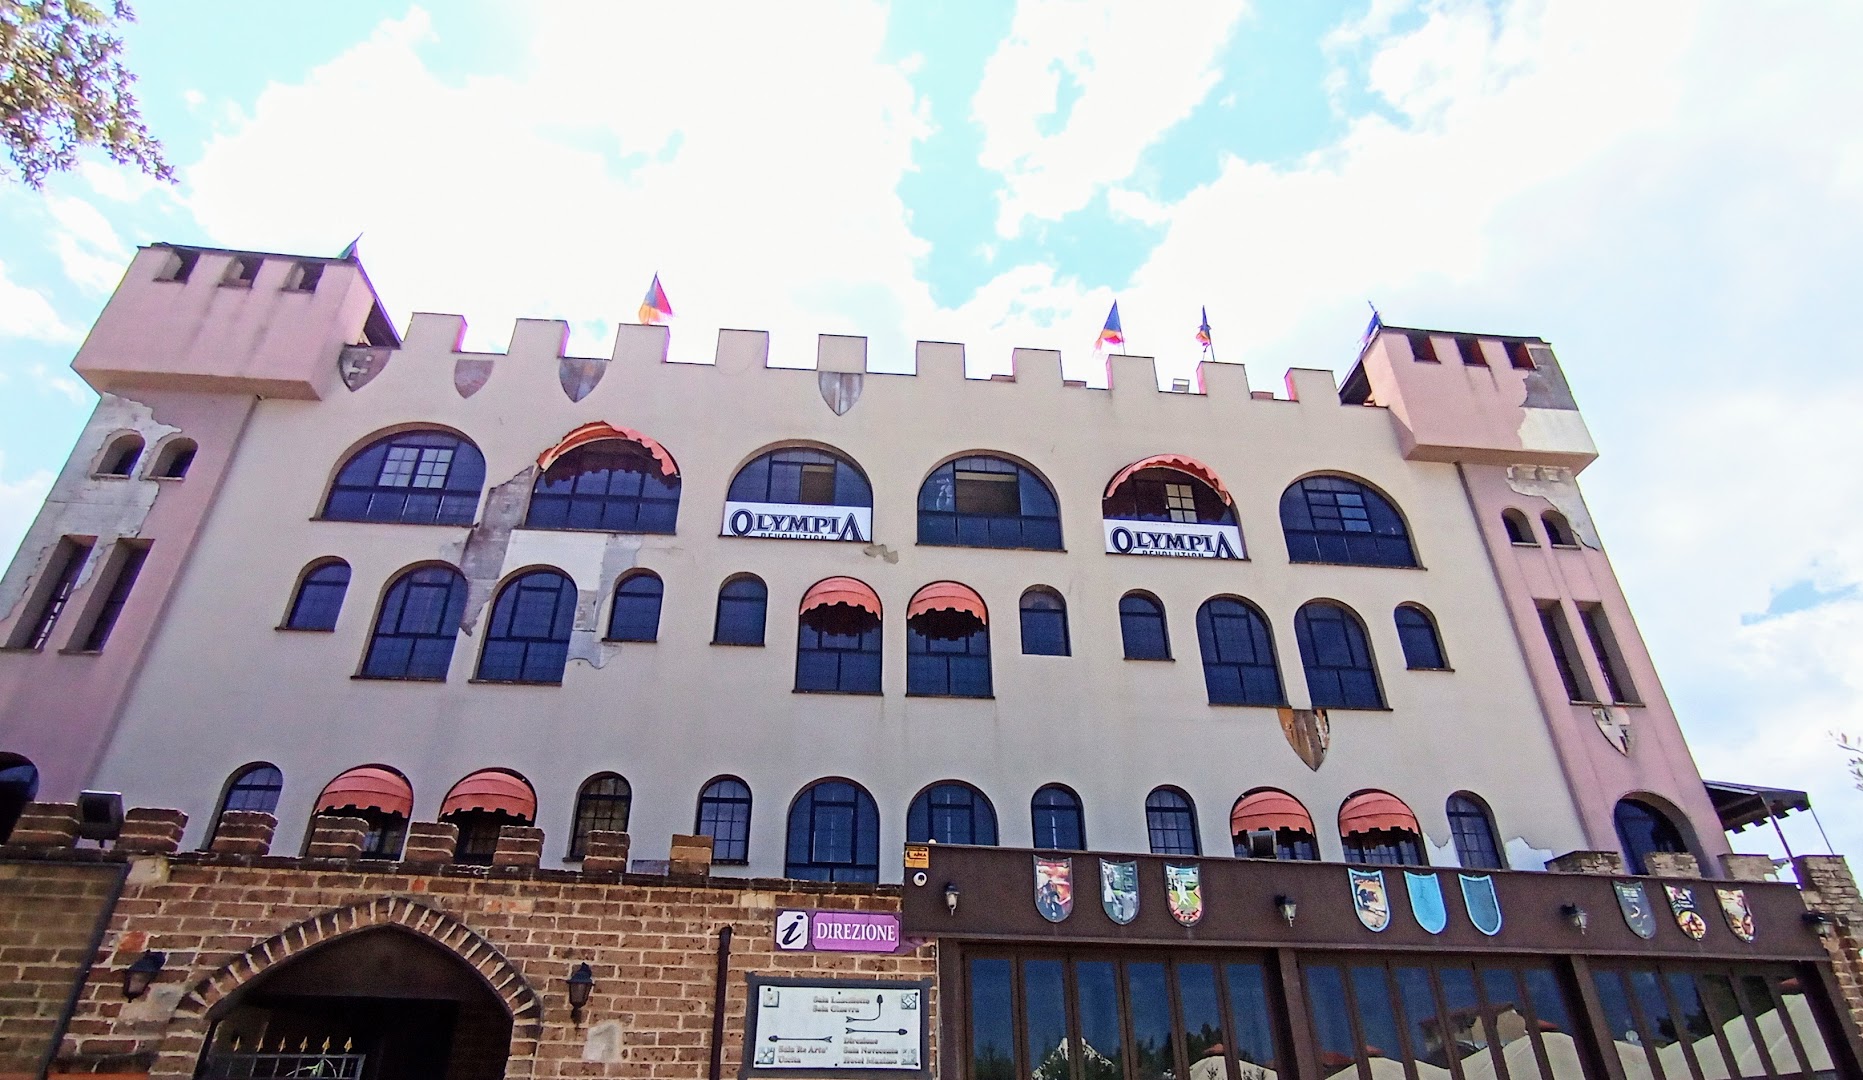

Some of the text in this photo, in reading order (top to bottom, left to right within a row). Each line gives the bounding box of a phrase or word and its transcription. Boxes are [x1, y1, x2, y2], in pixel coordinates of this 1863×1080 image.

[729, 509, 864, 542] OLYMPIA
[1110, 526, 1238, 559] OLYMPIA
[816, 922, 896, 942] DIREZIONE
